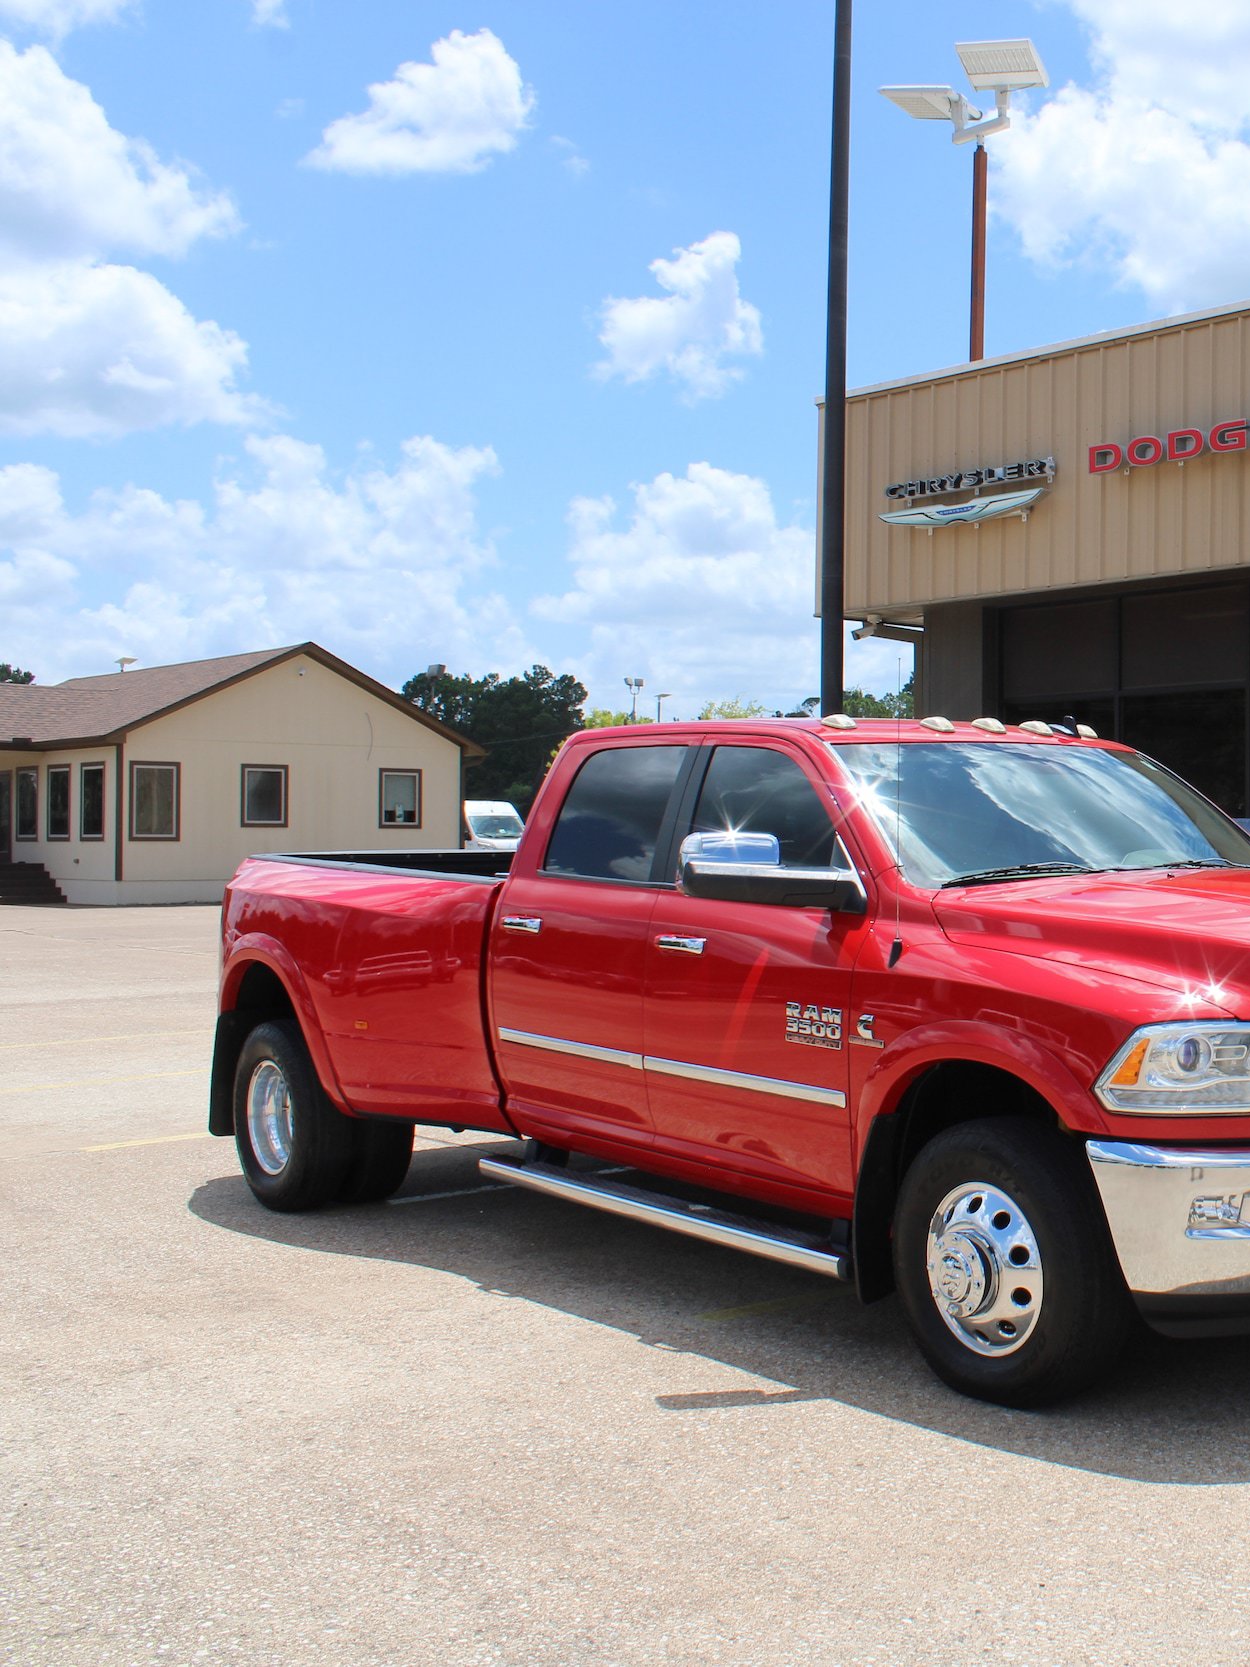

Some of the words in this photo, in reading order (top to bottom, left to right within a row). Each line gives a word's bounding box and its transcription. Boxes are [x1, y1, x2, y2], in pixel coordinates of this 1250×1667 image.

[885, 459, 1047, 499] CHRYSLER
[786, 1001, 842, 1024] RAM
[786, 1017, 841, 1039] 3500
